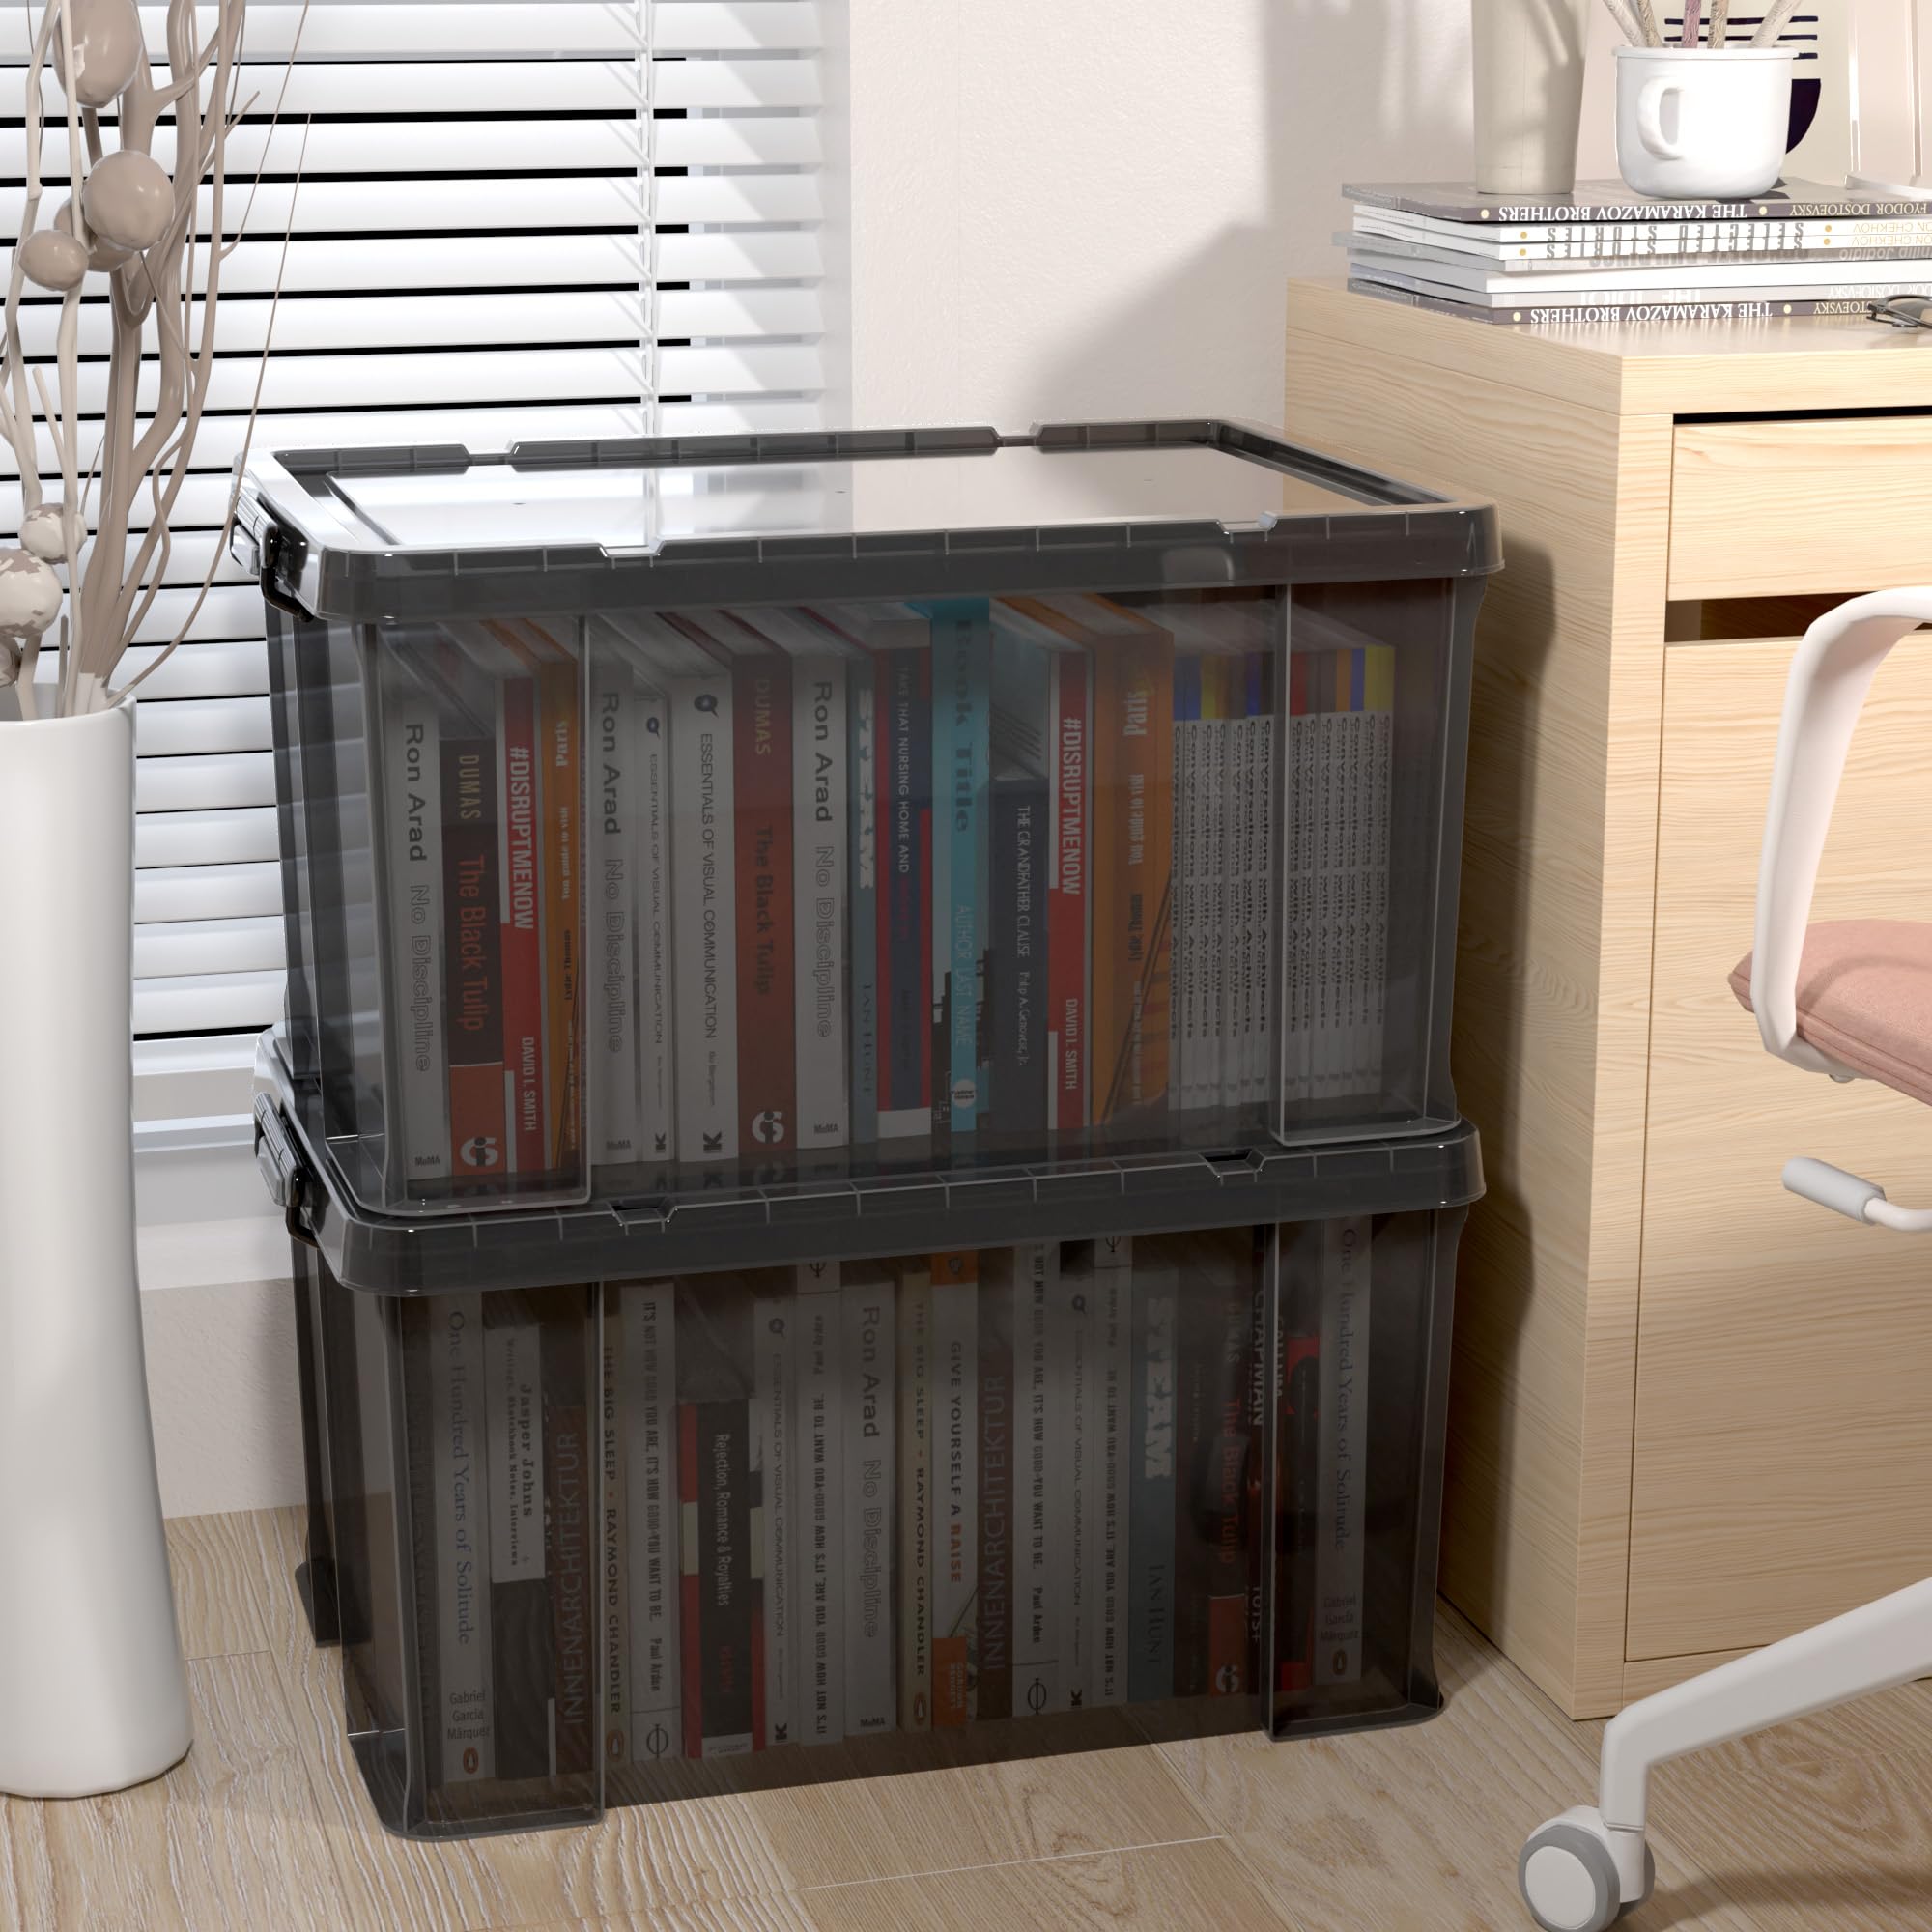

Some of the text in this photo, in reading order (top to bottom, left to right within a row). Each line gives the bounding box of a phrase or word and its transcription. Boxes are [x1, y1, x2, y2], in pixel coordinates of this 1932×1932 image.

[1498, 202, 1928, 222] THE KARAMAZOV BROTHERS FYODOR DOSTOEVSKY
[1547, 222, 1914, 242] SELECTED STORIES CHEKHOV
[1546, 239, 1657, 259] STORIES
[1677, 236, 1804, 253] SELECTED
[1851, 235, 1913, 246] CHEKHOV
[1529, 300, 1873, 324] THE KARAMAZOV BROTHERS TOEVSKY
[897, 701, 912, 734] THAT
[700, 733, 715, 825] ESSENTIALS
[896, 735, 913, 797] NURSING
[955, 741, 973, 833] Title
[649, 753, 662, 841] ESSENTIALS
[896, 800, 911, 841] HOME
[1016, 805, 1031, 827] THE
[650, 843, 661, 866] OF
[703, 829, 715, 853] OF
[753, 678, 777, 997] DUMAS The Black Tulip
[811, 679, 837, 1038] Ron Arad No Discipline
[896, 843, 911, 873] AND
[455, 754, 490, 1032] DUMAS The Black Tulip
[602, 692, 628, 1052] Ron Arad No Discipline
[651, 867, 663, 917] VISUAL
[703, 854, 717, 905] VISUAL
[1016, 831, 1032, 913] GRANDFATHER
[405, 724, 435, 1074] Ron Arad No Discipline
[1062, 717, 1083, 1090] #DISRUPTMENOW DAVID SMITH
[509, 745, 538, 1132] #DISRUPTMENOW DAVID SMITH
[954, 904, 974, 960] AUTHOR
[1015, 915, 1031, 958] CLAUSE
[652, 921, 666, 1045] COMMUNICATION
[702, 909, 718, 1039] COMMUNICATION
[954, 967, 974, 1000] LAST
[954, 1004, 973, 1047] NAME
[642, 1301, 657, 1322] IT'S
[604, 1387, 616, 1420] BIG
[1145, 1296, 1173, 1479] STEAM
[1335, 1228, 1359, 1549] One Hundred Years of Solitude
[645, 1406, 658, 1426] YOU
[518, 1383, 535, 1518] Jasper Johns
[605, 1428, 616, 1482] SLEEP
[646, 1456, 659, 1475] IT'S
[773, 1441, 783, 1463] OF
[859, 1304, 883, 1639] Ron Arad No Discipline
[950, 1341, 963, 1585] GIVE YOURSELF A RAISE
[448, 1310, 475, 1645] One Hundred Years of Solitude
[647, 1477, 660, 1500] HOW
[774, 1463, 784, 1514] VISUAL
[1215, 1397, 1241, 1565] The Black Tulip
[712, 1433, 734, 1606] Rejection, Romance & Royalties
[916, 1385, 926, 1677] SLEEP RAYMOND CHANDLER
[983, 1374, 1007, 1670] INNENARCHITEKTUR
[556, 1431, 586, 1724] INNENARCHITEKTUR
[606, 1508, 619, 1607] RAYMOND
[648, 1557, 662, 1585] WANT
[775, 1515, 786, 1638] COMMUNICATION
[649, 1588, 662, 1602] TO
[815, 1605, 827, 1627] YOU
[608, 1613, 620, 1715] CHANDLER
[816, 1662, 827, 1686] HOW
[816, 1691, 827, 1711] NOT
[816, 1714, 827, 1734] IT'S
